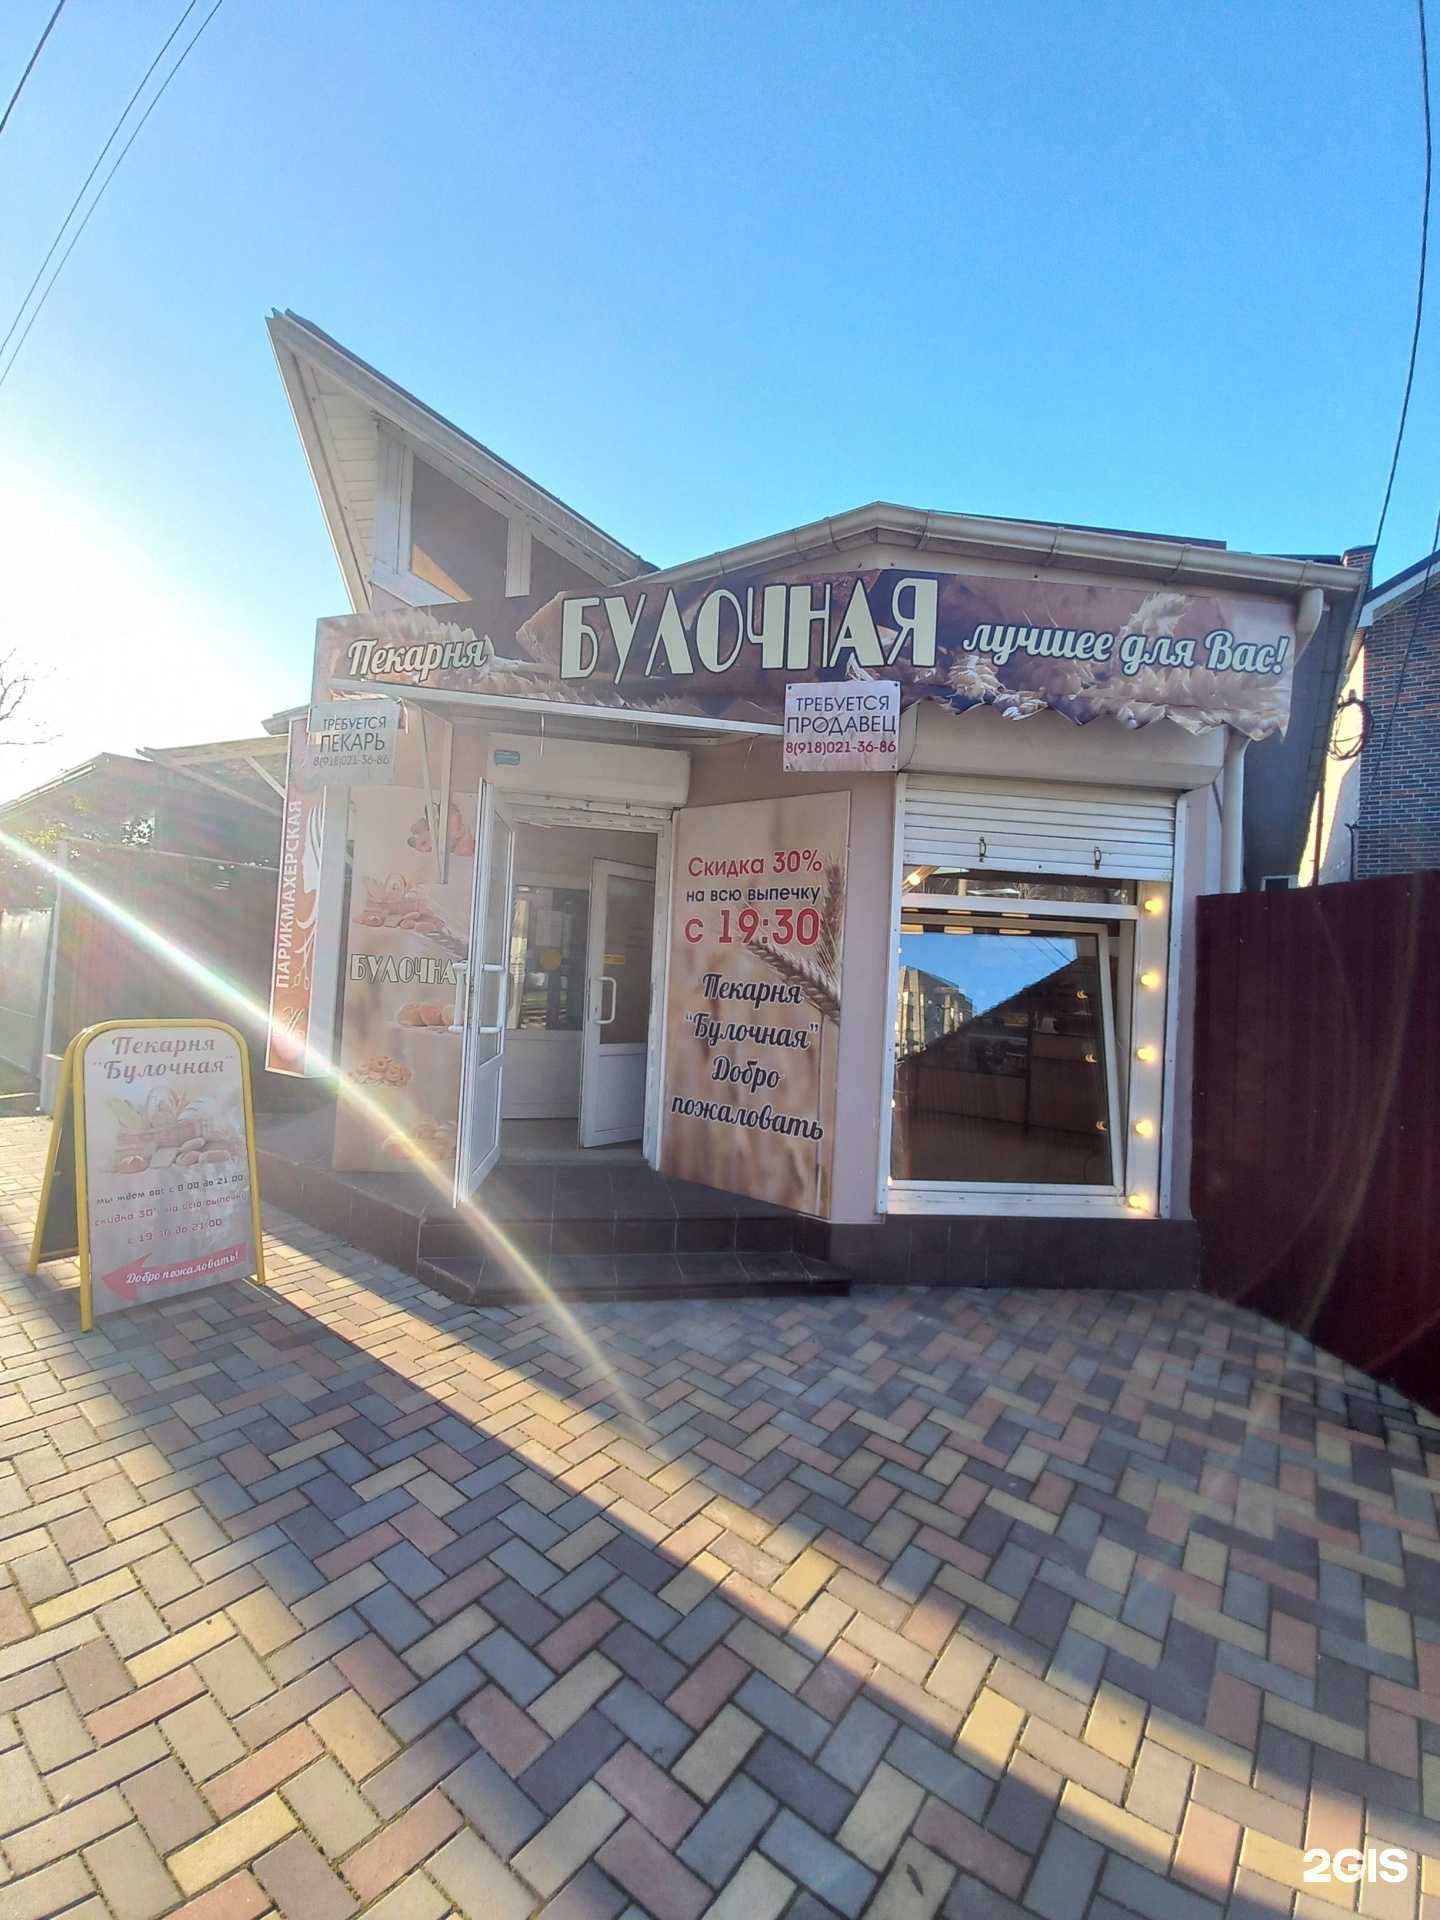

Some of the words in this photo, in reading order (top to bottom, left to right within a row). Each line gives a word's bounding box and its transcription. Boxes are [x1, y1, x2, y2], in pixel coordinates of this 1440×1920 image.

[348, 638, 488, 683] Пекарня
[560, 576, 939, 684] БУЛОЧНАЯ
[962, 623, 1113, 665] лучшее
[1120, 633, 1196, 674] для
[1203, 630, 1291, 675] Вас!
[796, 695, 890, 712] ТРЕБУЕТСЯ
[323, 716, 387, 731] ТРЕБУЕТСЯ
[786, 715, 897, 736] ПРОДАВЕЦ
[320, 732, 386, 753] ПЕКАРЬ
[785, 740, 897, 756] 8(918)021-36-86
[688, 857, 764, 877] Скидка
[772, 850, 823, 873] 30%
[275, 801, 302, 989] ПАРИКМАХЕРСКАЯ
[686, 889, 705, 902] на
[710, 888, 742, 902] всю
[748, 886, 821, 903] выпечку
[684, 918, 704, 944] с
[718, 907, 821, 945] 19:30
[702, 974, 801, 1009] Пекарня
[112, 1036, 216, 1057] Пекарня
[712, 1056, 780, 1093] Добро
[672, 1096, 824, 1140] пожаловать
[217, 1174, 244, 1185] 2100
[126, 1270, 160, 1284] Добро
[163, 1252, 239, 1279] пожаловать!
